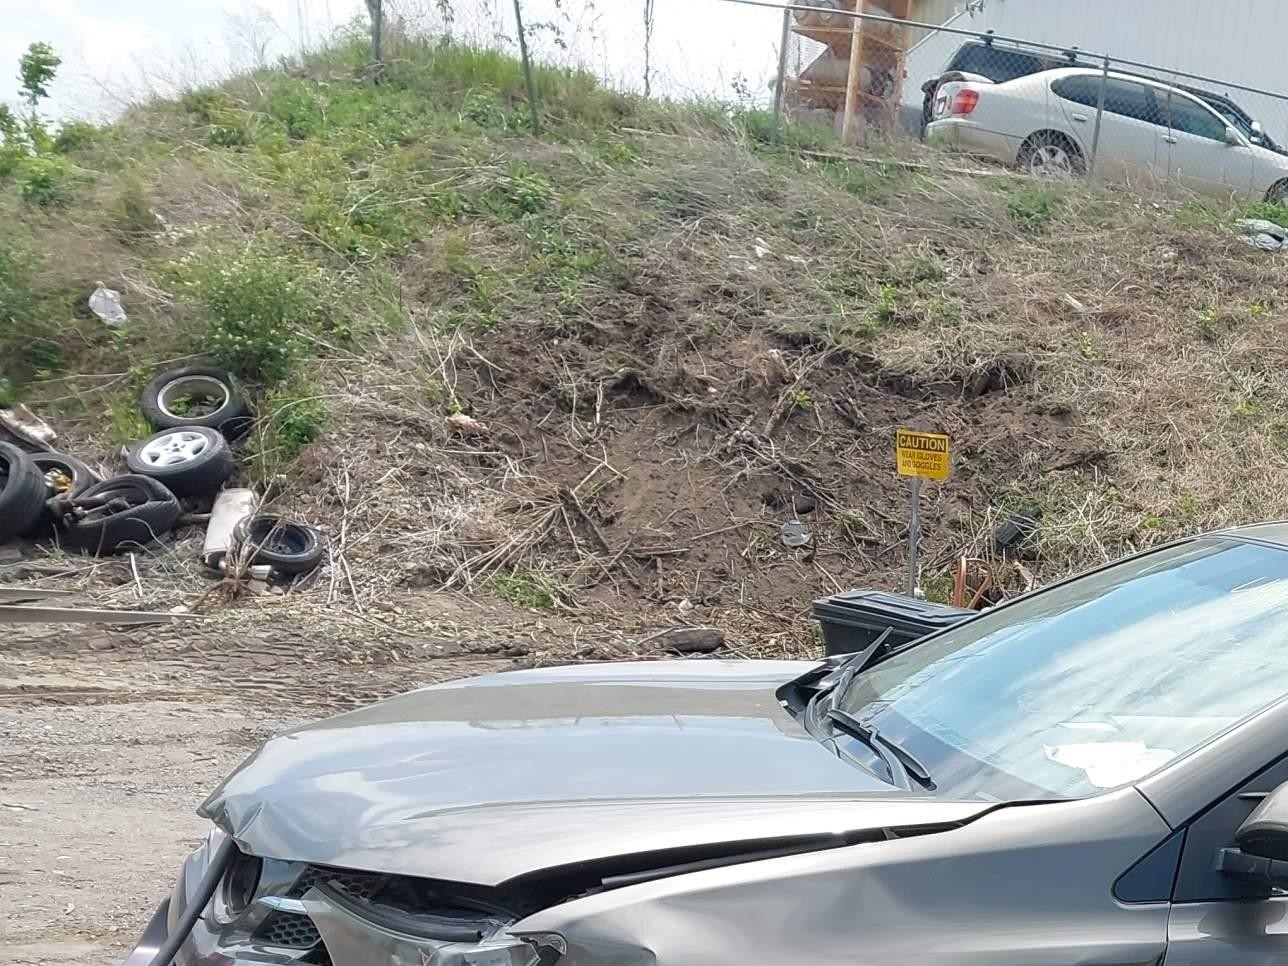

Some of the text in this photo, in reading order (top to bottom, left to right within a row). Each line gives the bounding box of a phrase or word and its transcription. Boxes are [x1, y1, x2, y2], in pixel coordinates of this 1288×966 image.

[899, 435, 945, 451] CAUTION
[901, 450, 942, 461] WEAR GLOVES
[912, 460, 941, 471] GOGGLES
